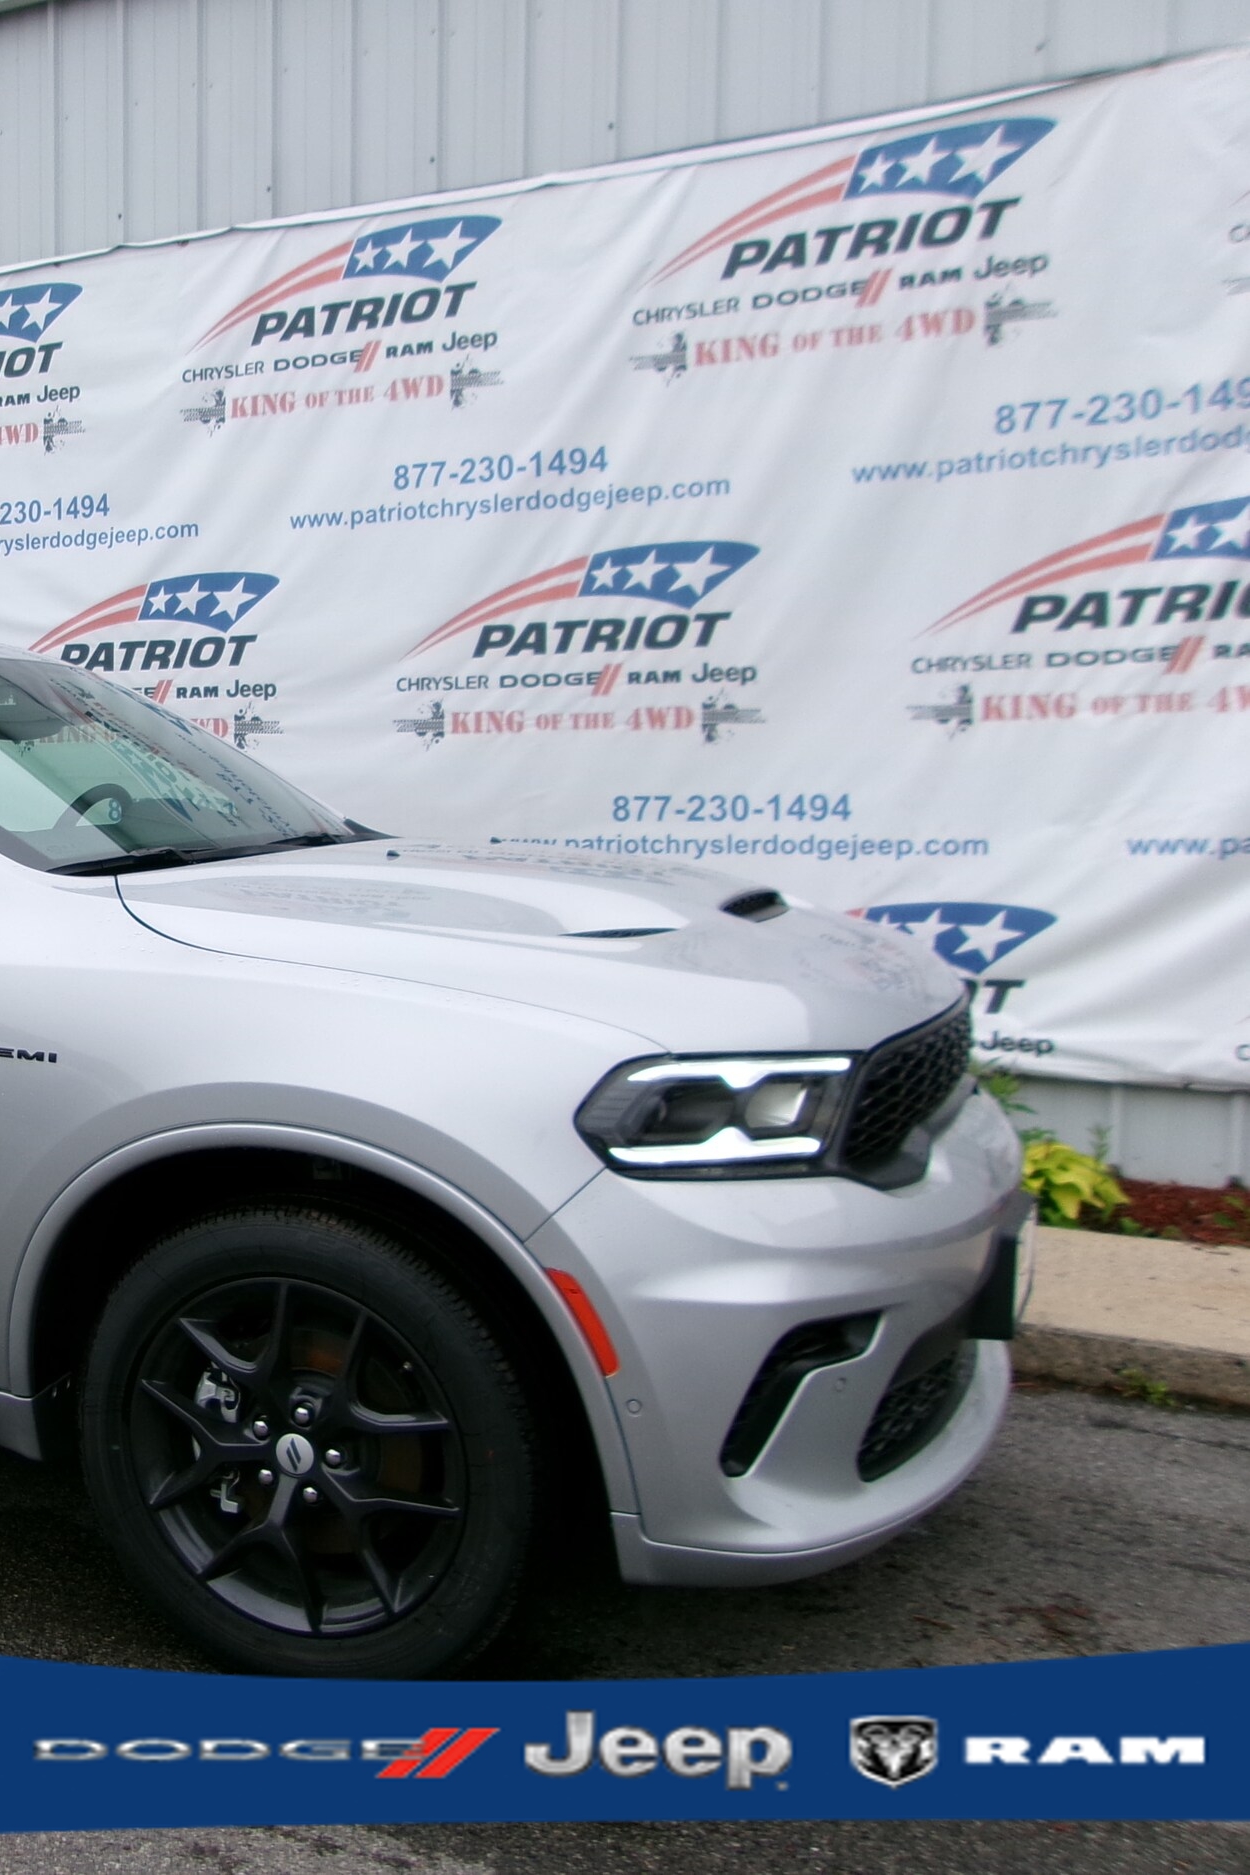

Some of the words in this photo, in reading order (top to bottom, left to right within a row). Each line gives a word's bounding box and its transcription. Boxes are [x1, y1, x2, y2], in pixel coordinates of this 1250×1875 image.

[721, 197, 1022, 280] PATRIOT
[632, 297, 740, 326] CHRYSLER
[752, 279, 867, 309] DODGE
[899, 267, 962, 291] RAM
[973, 251, 1049, 282] Jeep
[251, 281, 477, 347] PATRIOT
[181, 360, 265, 383] CHRYSLER
[273, 349, 362, 373] DODGE
[384, 339, 434, 359] RAM
[442, 330, 498, 354] Jeep
[694, 333, 781, 367] KING
[792, 329, 823, 352] OF
[831, 324, 882, 347] THE
[896, 308, 977, 343] 4WD
[36, 385, 81, 402] Jeep
[231, 391, 297, 419] KING
[305, 391, 330, 409] OF
[334, 384, 374, 406] THE
[382, 374, 444, 403] 4WD
[393, 445, 608, 491] 877-230-1494
[852, 427, 1250, 483] www.patriotchryslerdod
[290, 476, 731, 529] www.patriotchryslerdodgejeep.com
[60, 634, 258, 673] PATRIOT
[472, 611, 732, 658] PATRIOT
[395, 675, 490, 693] CHRYSLER
[499, 671, 601, 689] DODGE
[627, 669, 681, 684] RAM
[691, 662, 758, 685] Jeep
[911, 653, 1032, 674] CHRYSLER
[1046, 644, 1179, 668] DODGE
[176, 685, 219, 698] RAM
[226, 679, 277, 700] Jeep
[980, 693, 1077, 722] KING
[1091, 694, 1124, 715] OF
[1137, 691, 1192, 713] THE
[450, 710, 525, 735] KING
[535, 711, 565, 731] OF
[568, 710, 615, 730] THE
[625, 707, 695, 731] 4WD
[612, 793, 852, 822] 877-230-1494
[980, 1031, 1054, 1057] Jeep
